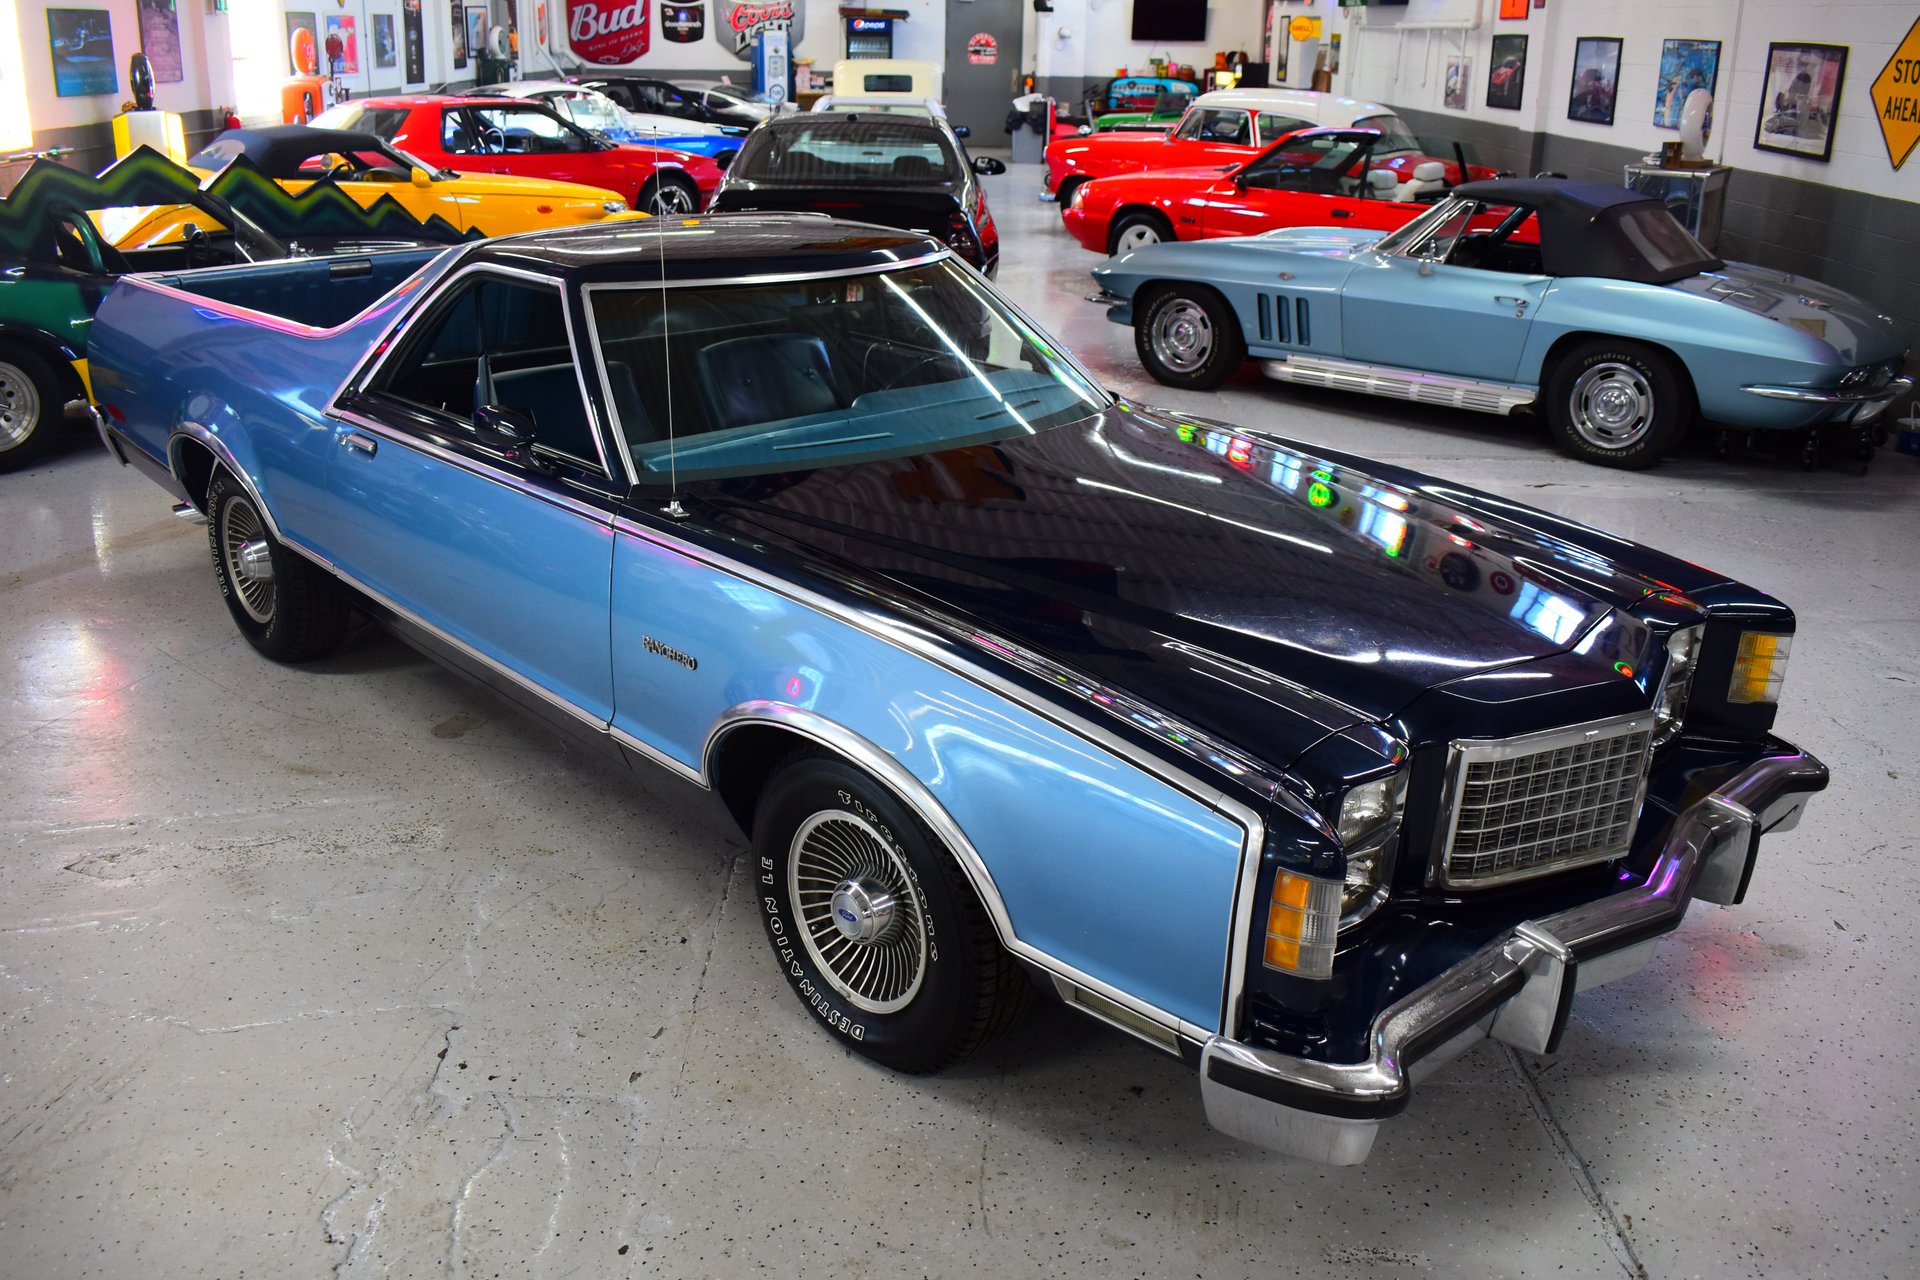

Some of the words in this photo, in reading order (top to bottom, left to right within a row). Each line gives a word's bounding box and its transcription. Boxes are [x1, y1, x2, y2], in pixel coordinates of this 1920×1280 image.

[571, 0, 646, 41] Bud
[727, 1, 792, 31] Coors
[864, 20, 885, 30] pepsi
[588, 42, 607, 51] KING
[620, 30, 643, 42] BEERS
[1883, 96, 1920, 123] AHEA
[1584, 352, 1632, 366] Radial
[1635, 360, 1652, 378] T/A
[1566, 425, 1646, 457] BFGoodrich
[208, 490, 230, 597] DESTINATION
[642, 635, 698, 670] RANCHERO
[761, 856, 774, 885] LE
[764, 897, 865, 1041] DESTINATION
